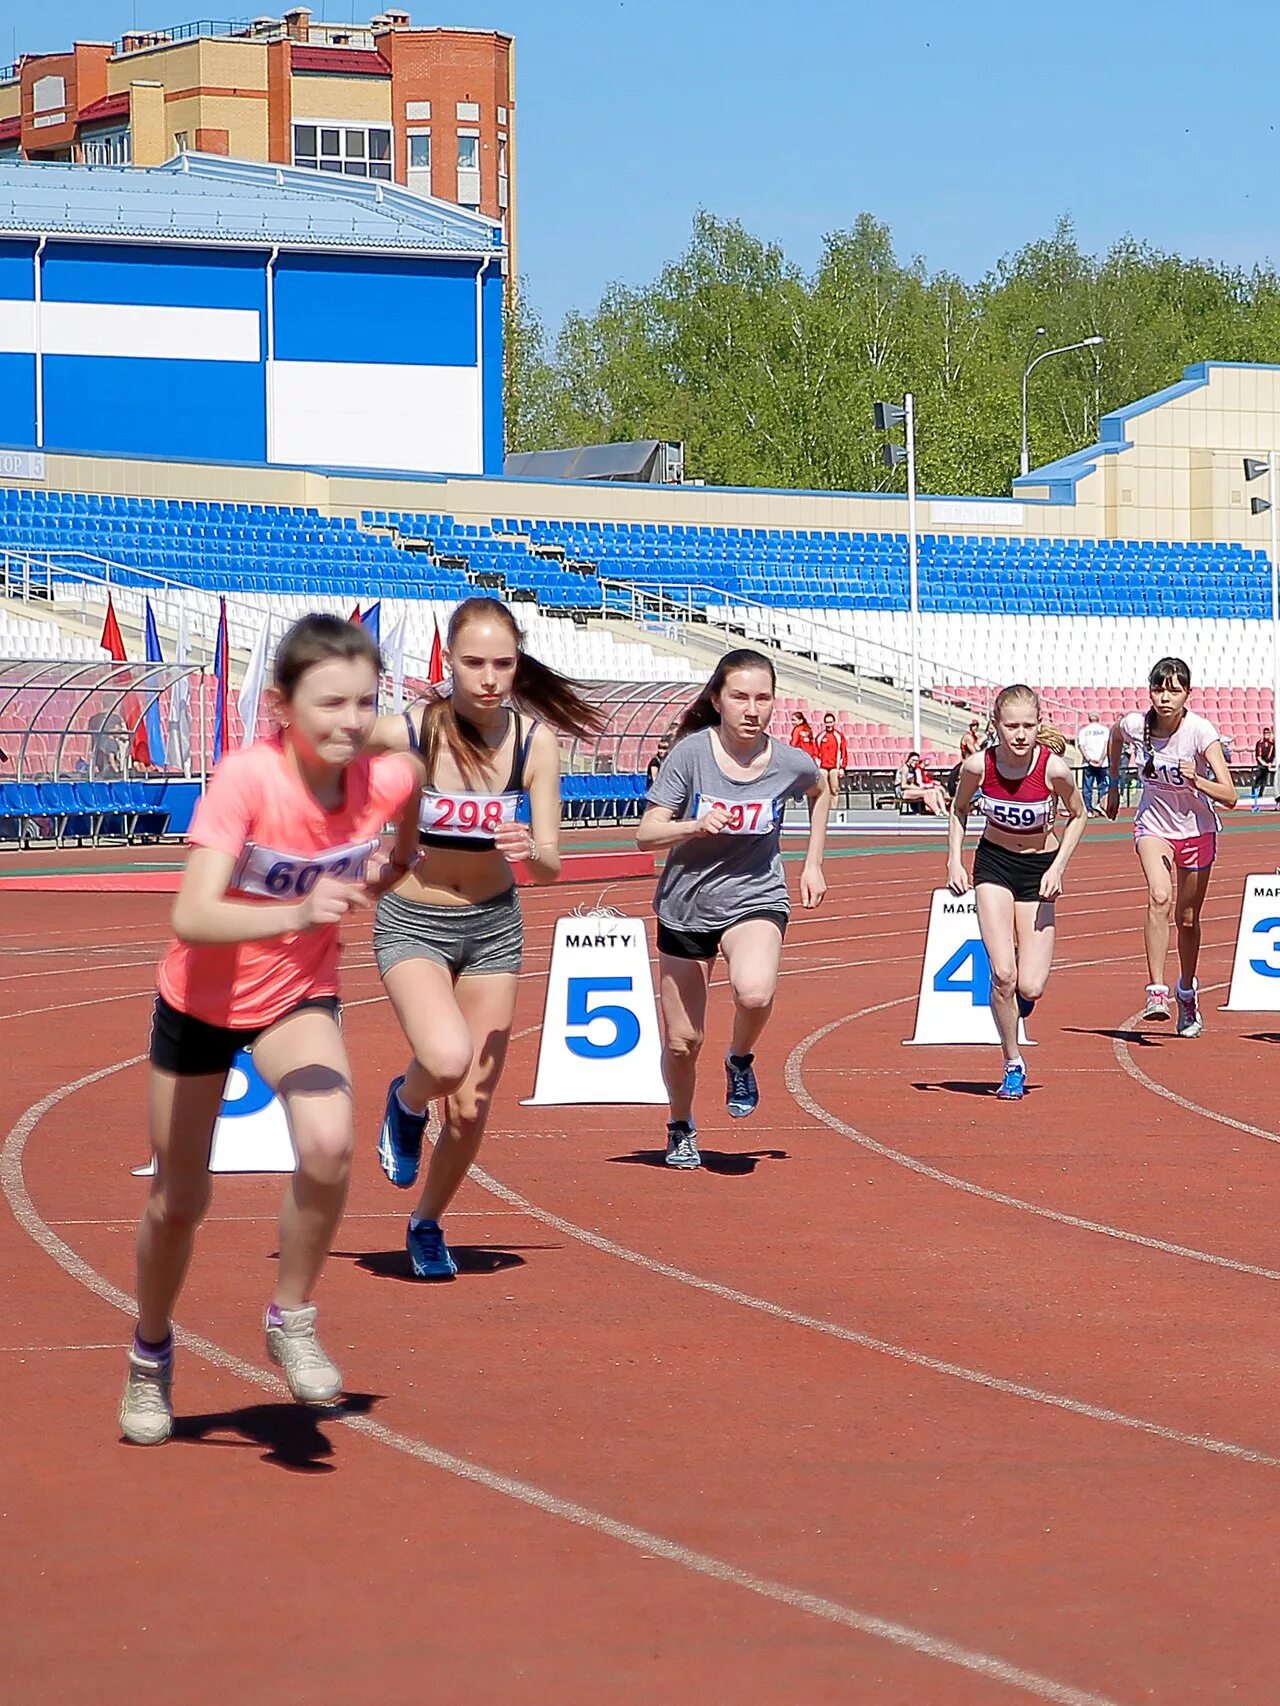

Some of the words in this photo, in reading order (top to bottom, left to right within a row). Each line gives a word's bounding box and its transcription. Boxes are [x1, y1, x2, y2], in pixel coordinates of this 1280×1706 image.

[34, 455, 42, 475] 5
[432, 798, 503, 833] 298
[712, 801, 762, 831] 97
[839, 813, 845, 822] 1
[994, 805, 1035, 826] 559
[943, 904, 977, 914] MAR
[566, 935, 631, 948] MARTY
[933, 939, 992, 1006] 4
[565, 976, 641, 1060] 5
